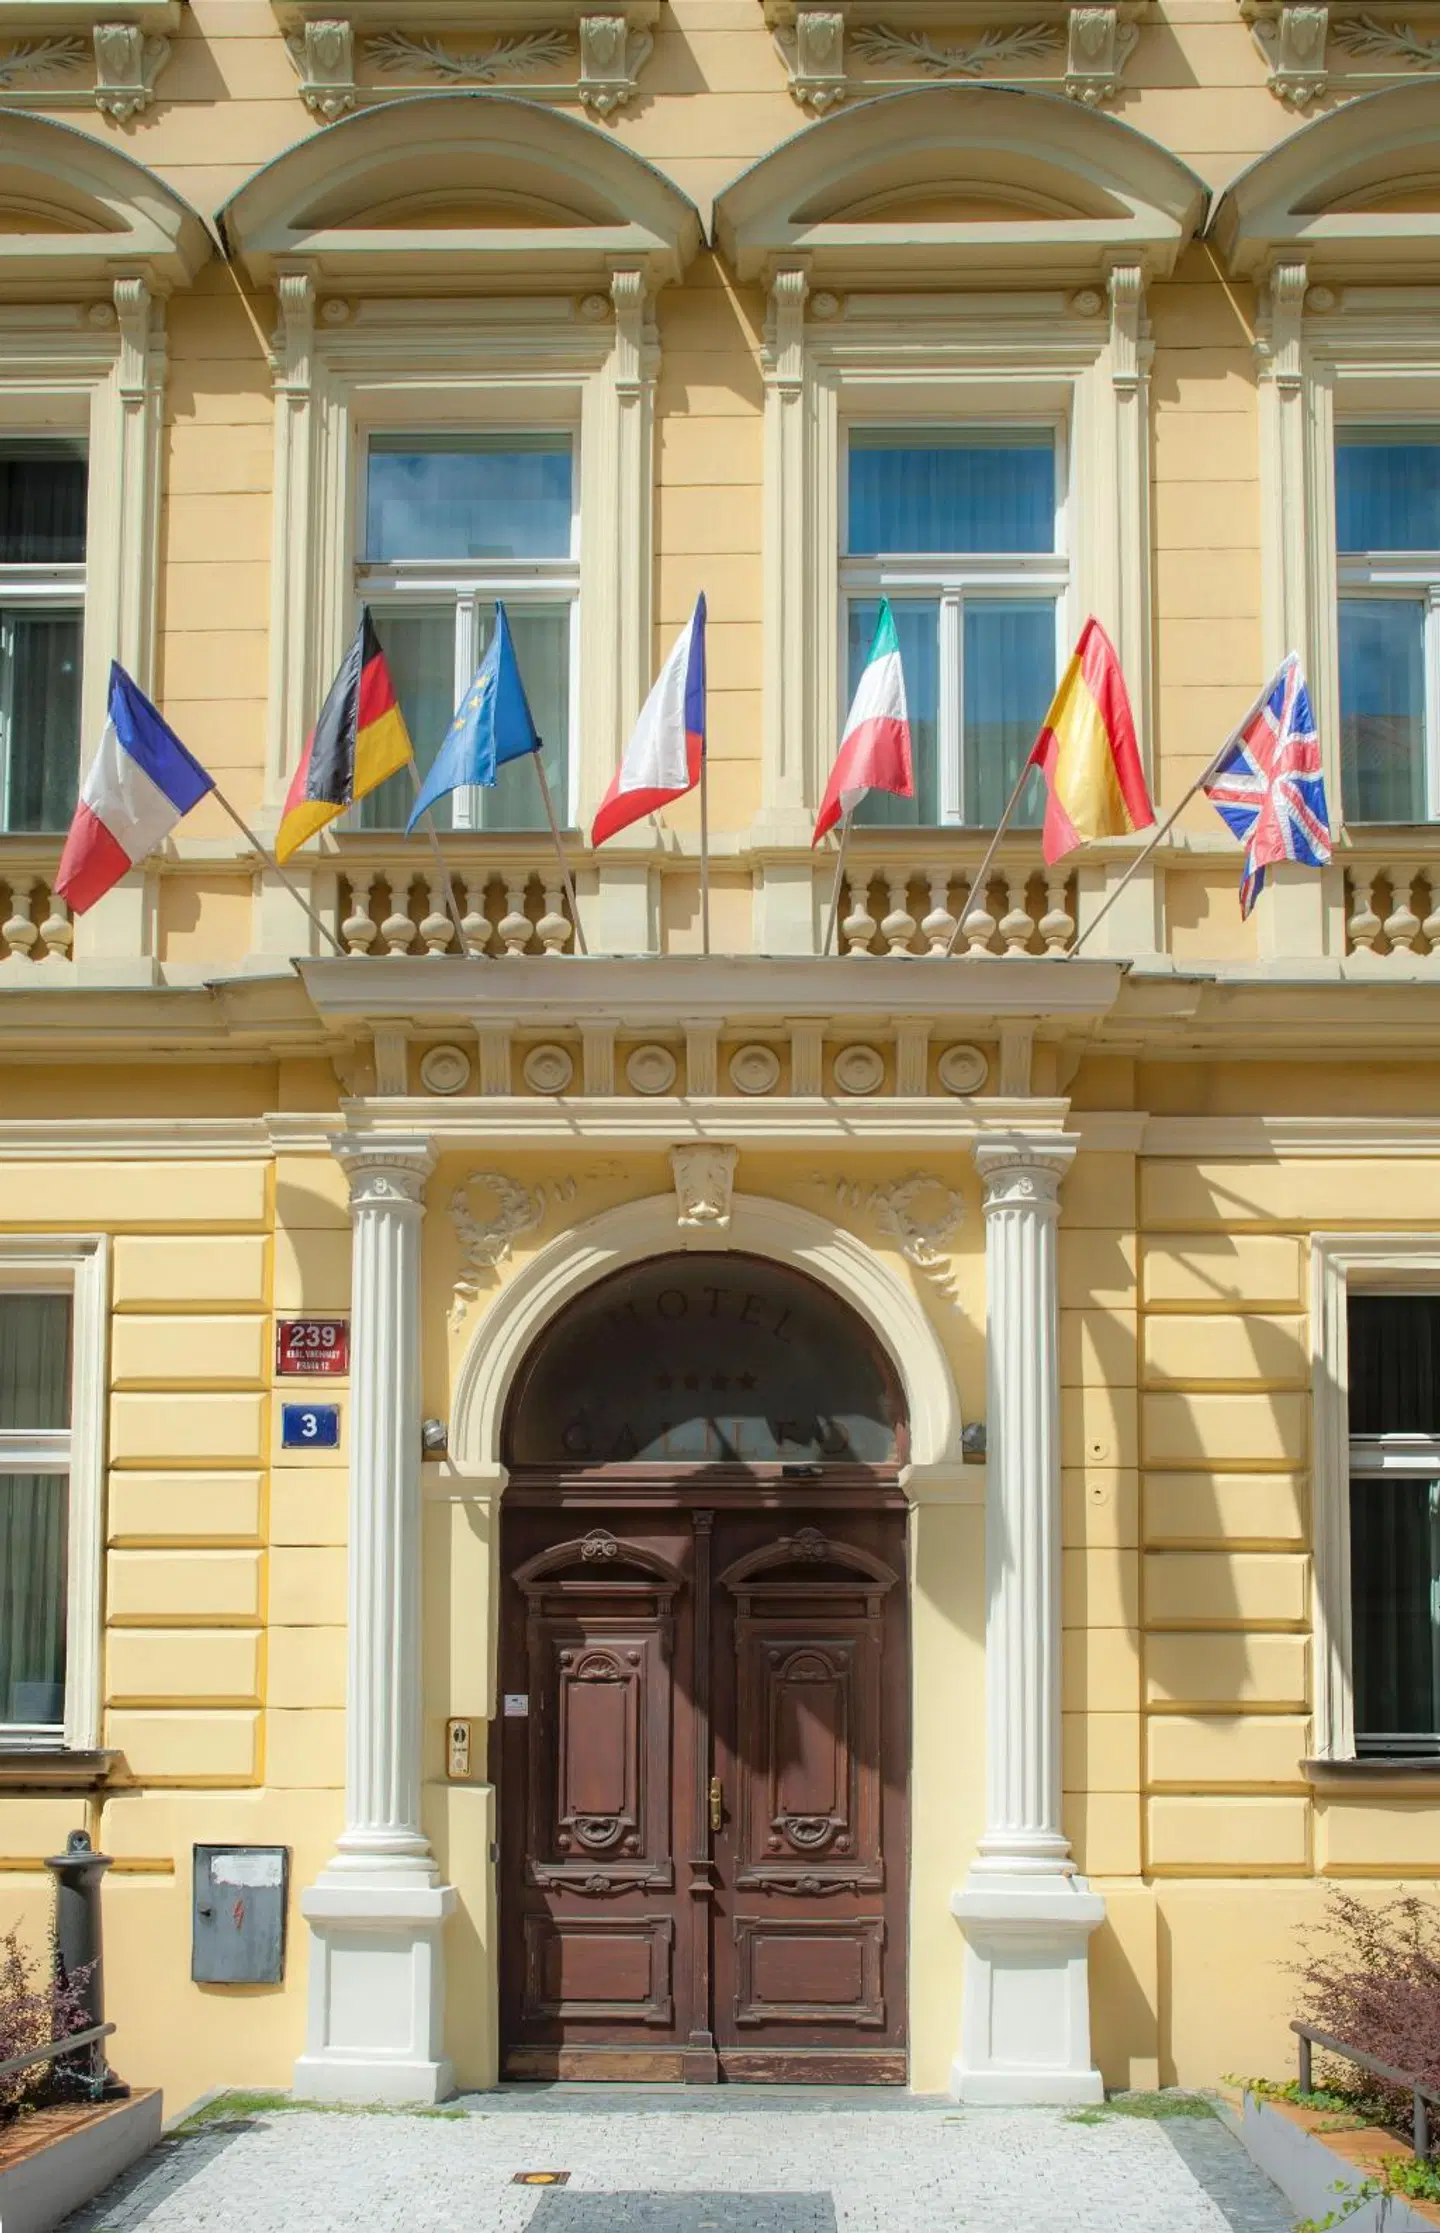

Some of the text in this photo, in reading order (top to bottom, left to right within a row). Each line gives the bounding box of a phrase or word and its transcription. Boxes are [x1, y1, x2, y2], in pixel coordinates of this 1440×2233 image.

[605, 1286, 793, 1343] HOTEL
[290, 1325, 336, 1347] 239
[301, 1413, 318, 1437] 3
